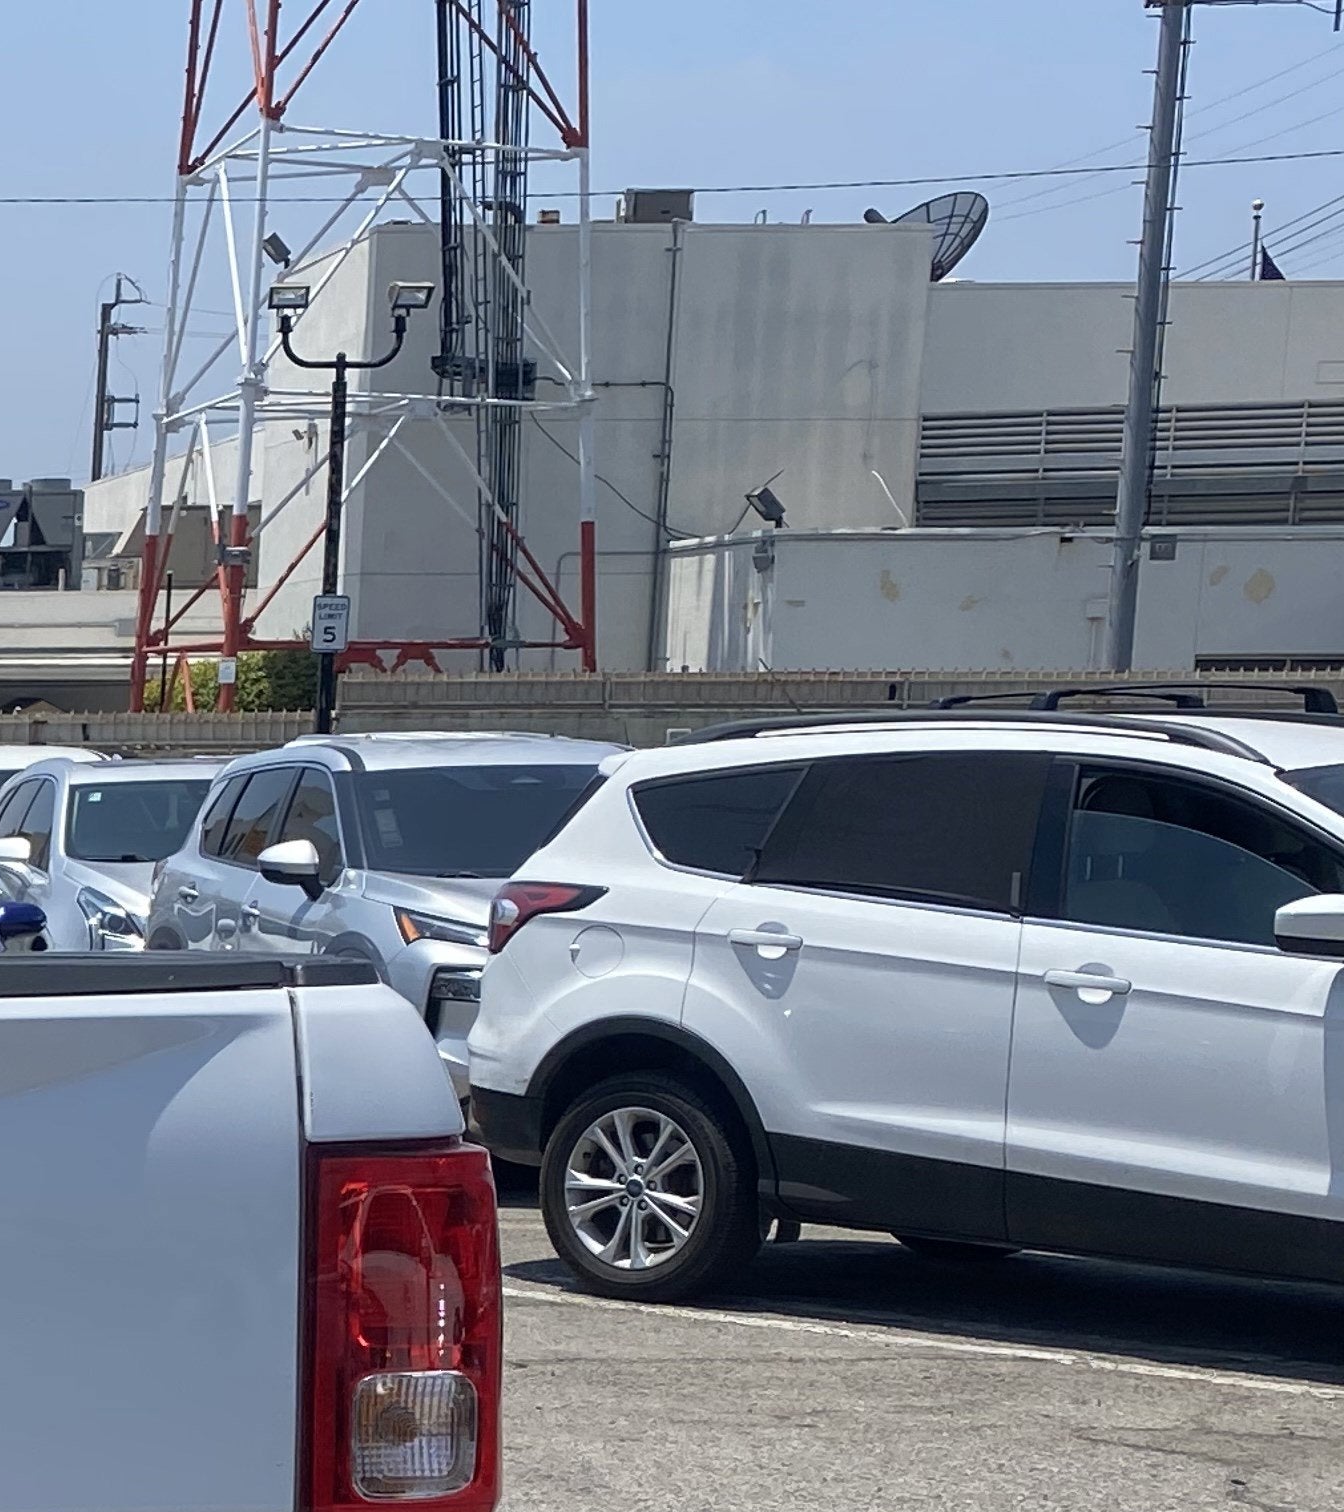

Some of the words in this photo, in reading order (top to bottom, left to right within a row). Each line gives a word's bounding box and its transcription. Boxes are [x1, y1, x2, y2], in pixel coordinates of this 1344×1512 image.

[317, 602, 347, 611] SPEED
[319, 612, 343, 620] LIMIT
[322, 626, 337, 643] 5
